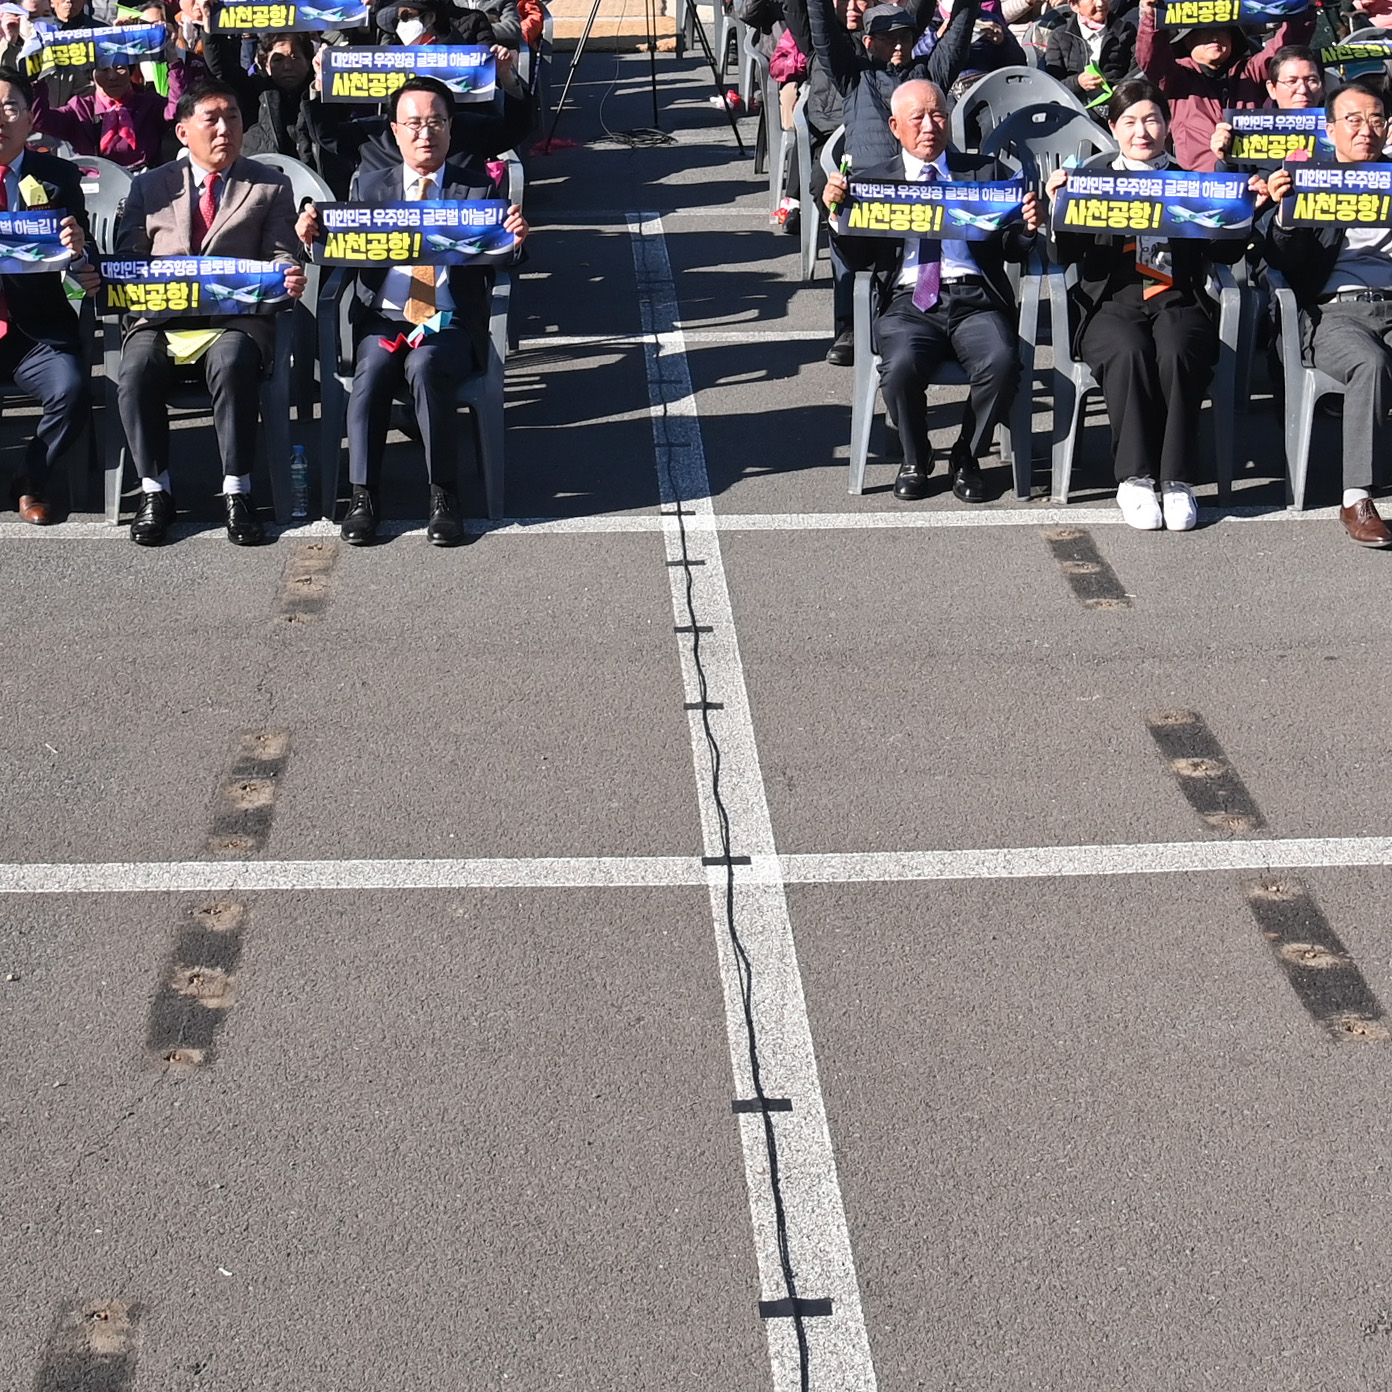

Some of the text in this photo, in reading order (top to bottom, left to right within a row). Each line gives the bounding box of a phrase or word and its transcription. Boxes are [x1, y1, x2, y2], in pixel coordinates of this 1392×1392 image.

[218, 5, 294, 27] 사천공항!
[1165, 0, 1239, 24] 사천공항!
[332, 52, 484, 67] 대한민국 우주항공 글로벌 하늘길!
[1233, 116, 1315, 130] 대한민국 우주항공
[1068, 177, 1243, 198] 대한민국 우주항공 글로벌 하늘길!
[1296, 169, 1341, 187] 대한민국
[1344, 171, 1390, 188] 우주항공
[850, 184, 1022, 201] 대한민국 우주항공 글로벌 하늘길!
[849, 203, 941, 231] 사천공항!
[1065, 201, 1161, 228] 사천공항!
[1294, 193, 1387, 221] 사천공항!
[13, 221, 56, 235] 하늘길!
[324, 209, 504, 227] 대한민국 우주항공 글로벌 하늘길!
[324, 233, 420, 259] 사천공항!
[101, 263, 147, 278] 대한민국
[150, 262, 197, 277] 우주항공
[199, 261, 234, 275] 글로벌
[108, 282, 198, 310] 사천공항!
